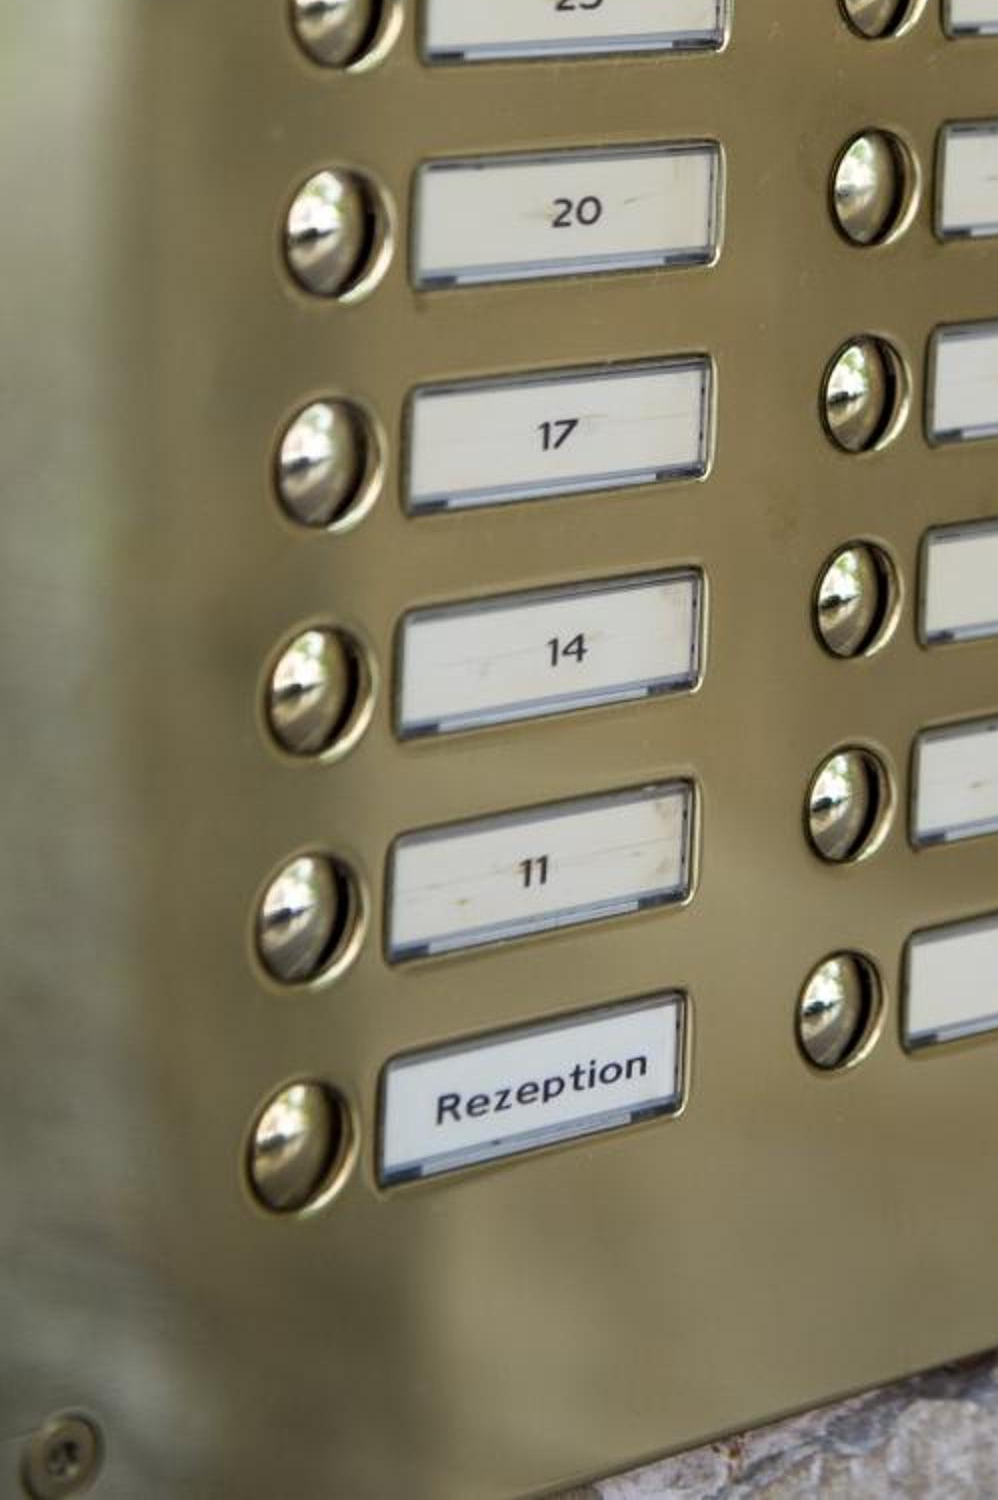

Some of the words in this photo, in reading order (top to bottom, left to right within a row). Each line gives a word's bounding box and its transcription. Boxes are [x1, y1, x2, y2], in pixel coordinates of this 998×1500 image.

[550, 195, 604, 229] 20
[537, 418, 580, 451] 17
[546, 632, 590, 667] 14
[518, 854, 549, 889] 11
[435, 1054, 649, 1127] Rezeption
